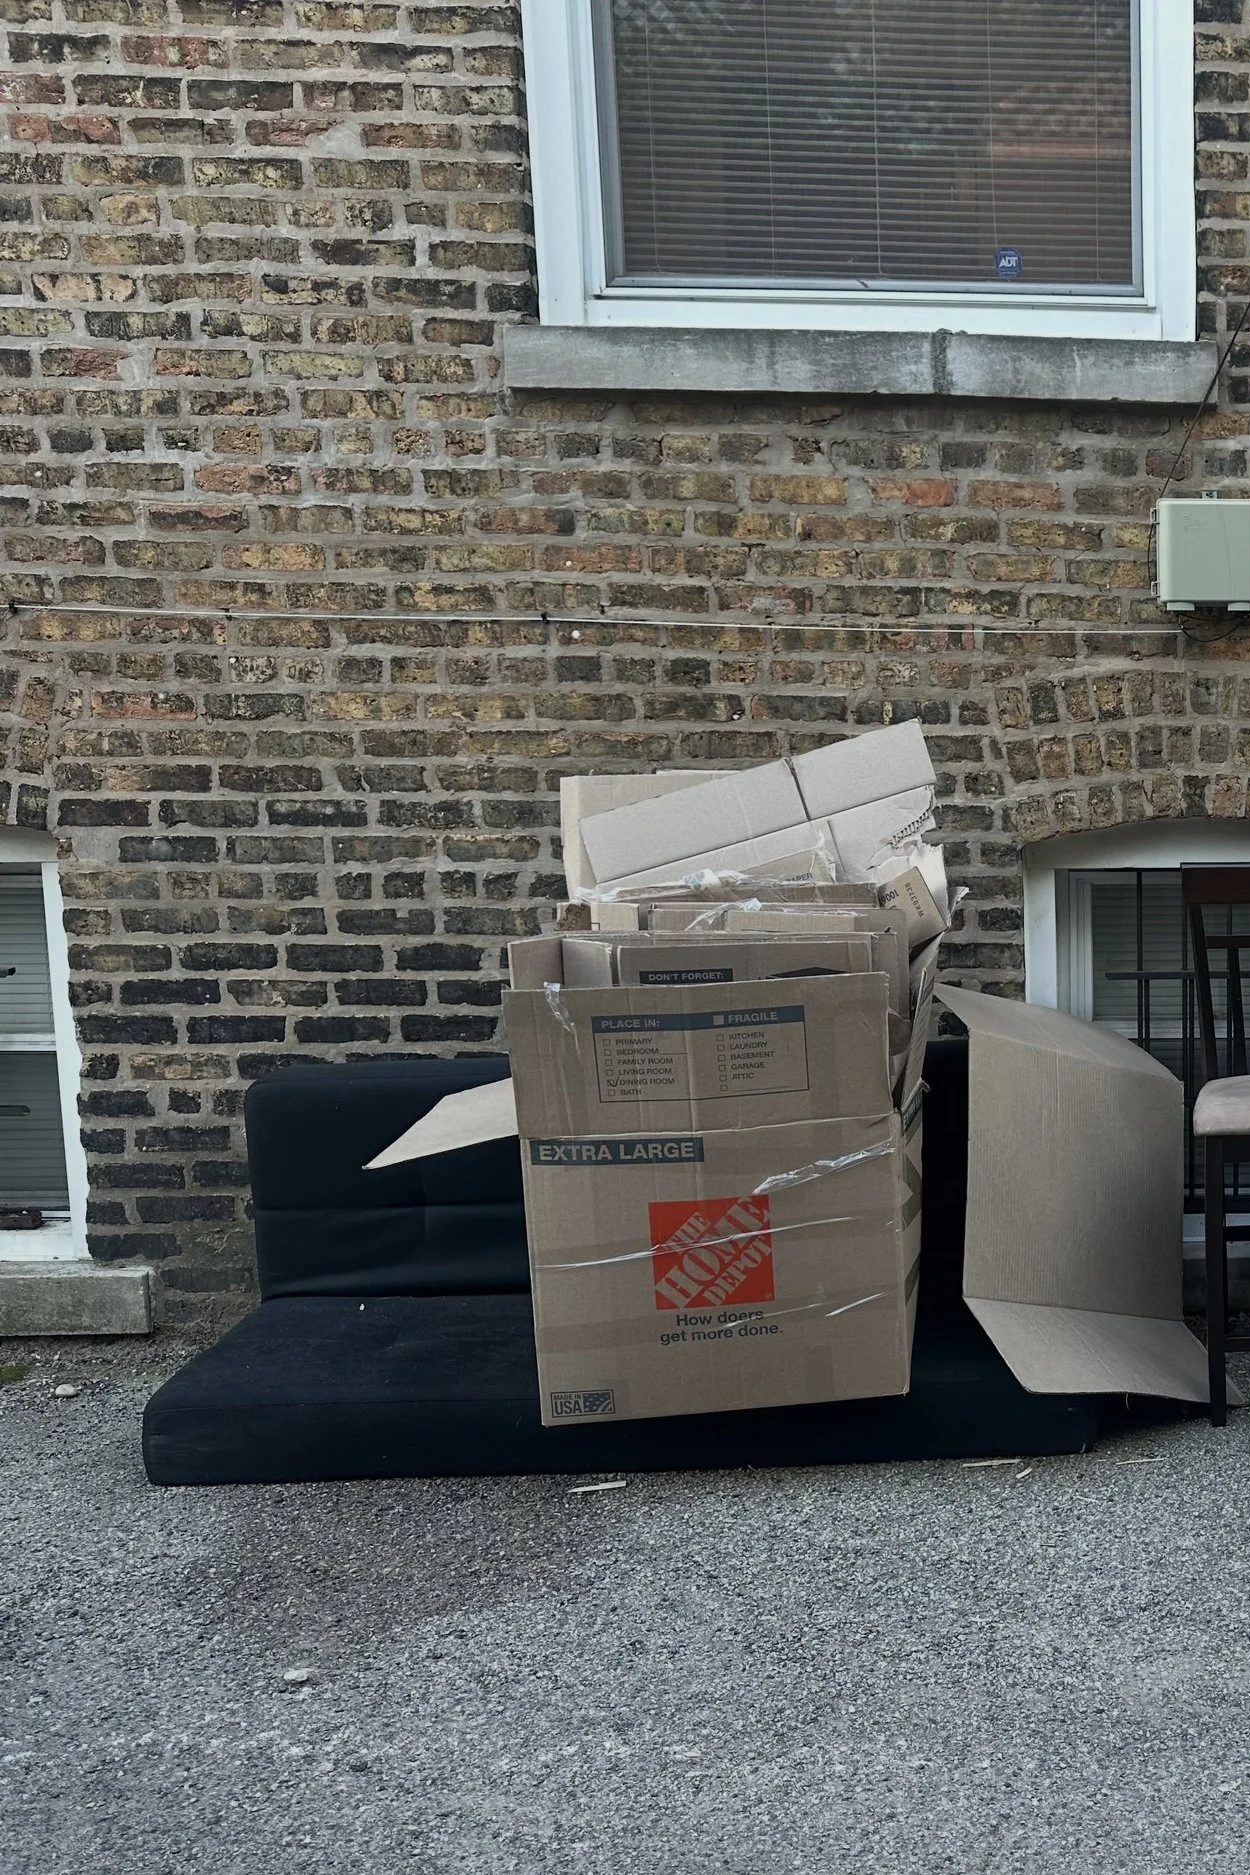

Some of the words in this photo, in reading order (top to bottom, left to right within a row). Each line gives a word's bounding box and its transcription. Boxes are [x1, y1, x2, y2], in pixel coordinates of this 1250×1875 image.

[999, 256, 1018, 268] ADT
[649, 973, 679, 981] DON'T
[682, 971, 724, 981] FORGET:
[728, 1011, 778, 1024] FRAGILE
[601, 1019, 641, 1029] PLACE
[644, 1018, 660, 1028] IN:
[729, 1032, 765, 1040] KITCHEN
[730, 1041, 768, 1050] LAUNDRY
[649, 1057, 673, 1065] ROOM
[731, 1051, 775, 1060] BASEMENT
[731, 1062, 765, 1070] GARAGE
[618, 1068, 645, 1076] LIVING
[732, 1072, 755, 1080] ATTIC
[619, 1078, 648, 1086] DINING
[649, 1077, 675, 1085] ROOM
[538, 1143, 613, 1161] EXTRA
[619, 1141, 695, 1159] LARGE
[664, 1211, 711, 1254] THE
[655, 1197, 770, 1309] HOME
[703, 1236, 772, 1307] DEPOT
[676, 1314, 712, 1327] How
[717, 1310, 764, 1323] doers
[660, 1329, 687, 1346] get
[691, 1328, 734, 1340] more
[554, 1400, 583, 1415] USA
